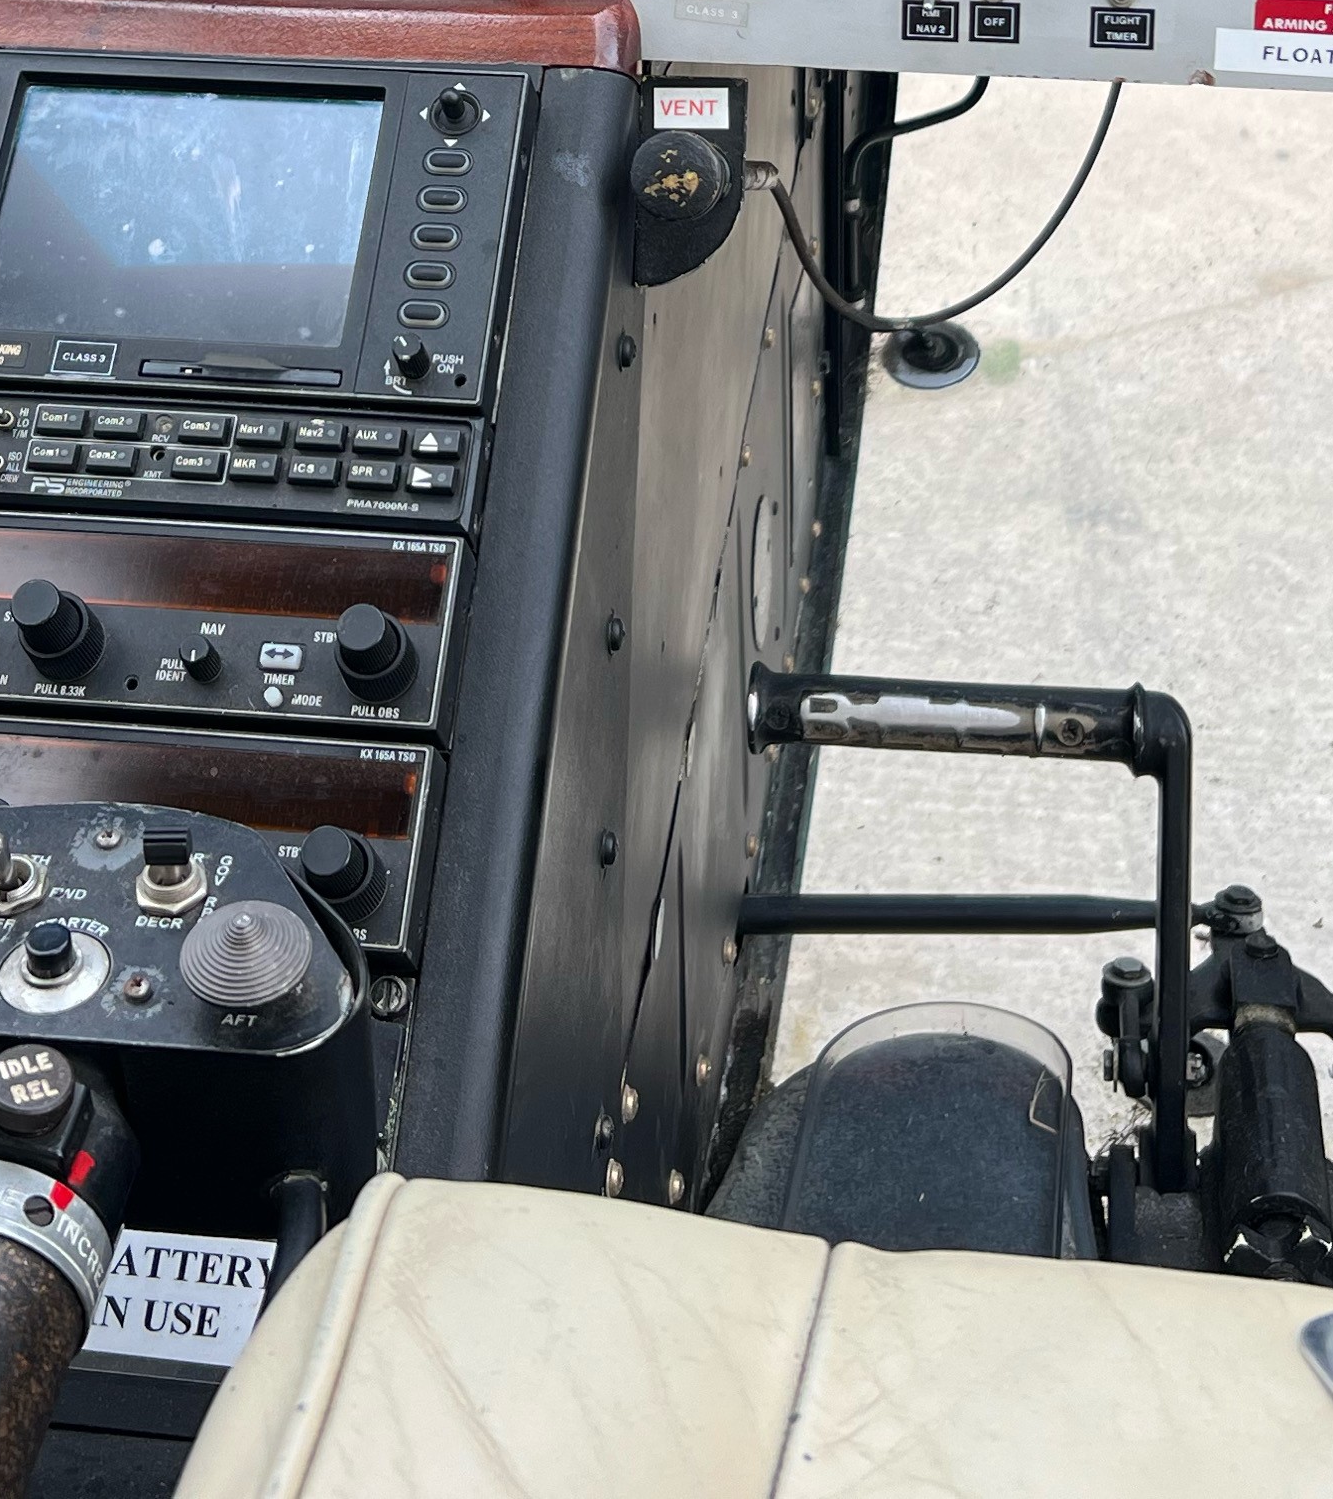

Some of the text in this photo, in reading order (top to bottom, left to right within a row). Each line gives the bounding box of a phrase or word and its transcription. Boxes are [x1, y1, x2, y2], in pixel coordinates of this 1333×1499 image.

[1104, 16, 1141, 25] FLIGHT
[1262, 18, 1328, 32] ARMING
[1105, 32, 1137, 42] TIMER
[660, 97, 719, 118] VENT
[200, 624, 225, 636] NAV
[350, 706, 400, 720] PULL OBS
[9, 1080, 59, 1105] REL
[110, 1243, 271, 1290] ATTERY
[144, 1298, 221, 1338] USE
